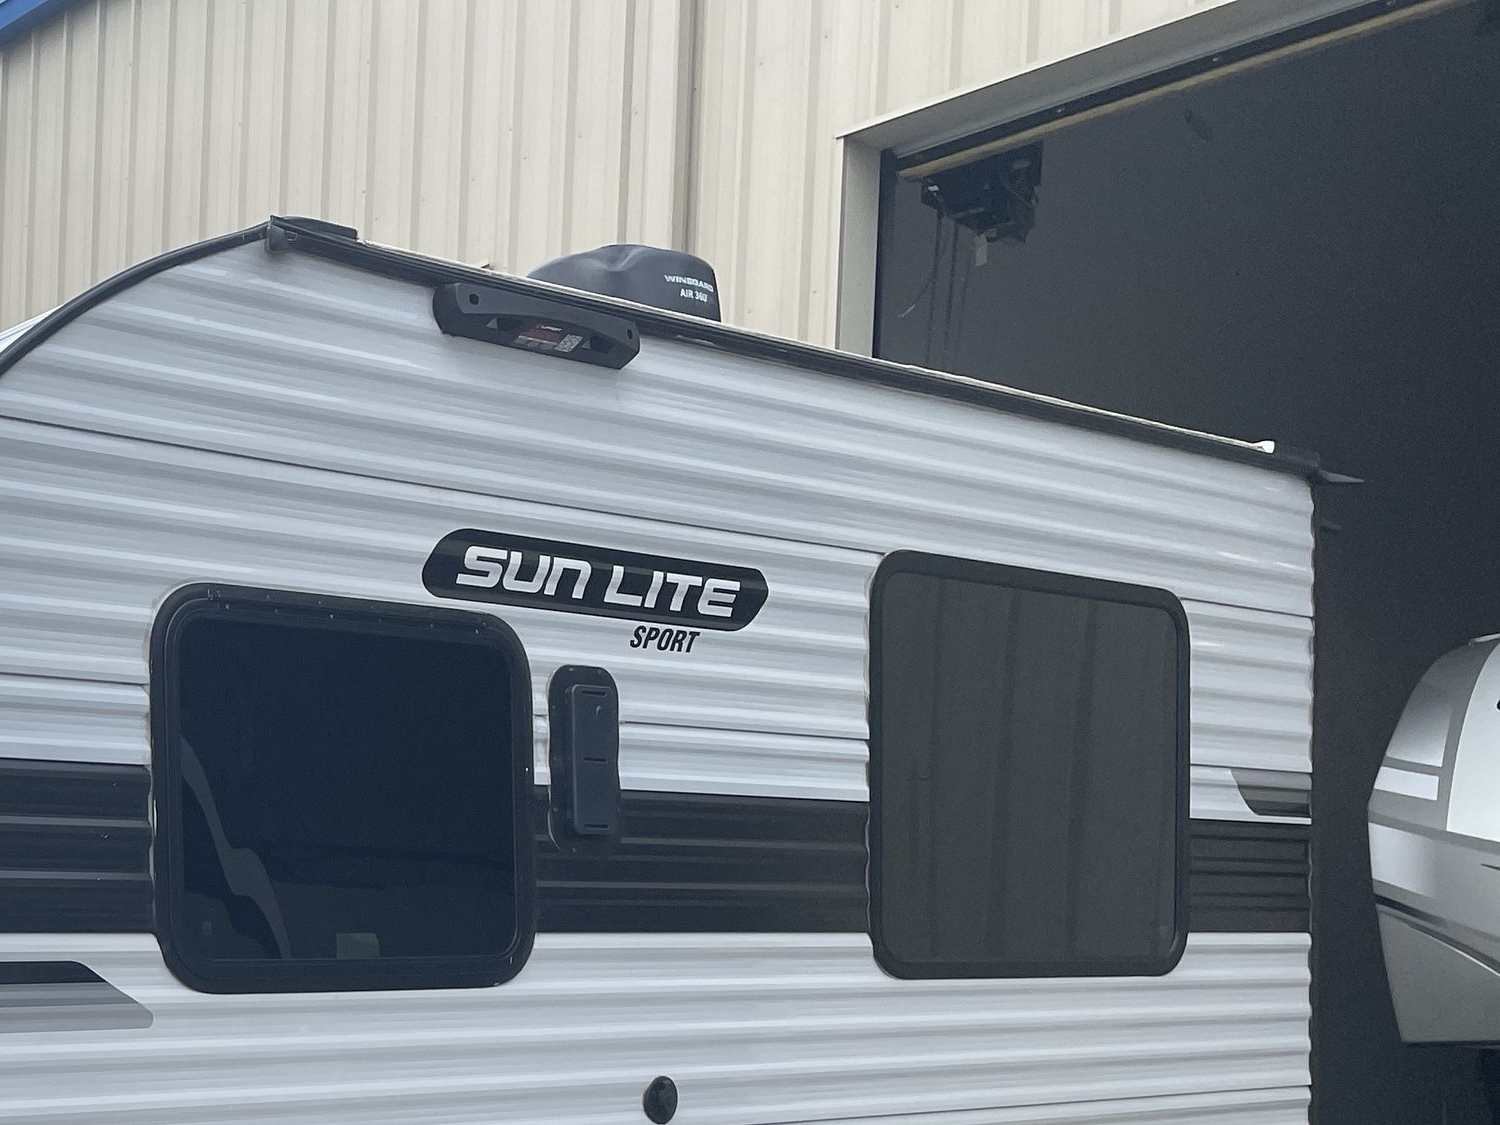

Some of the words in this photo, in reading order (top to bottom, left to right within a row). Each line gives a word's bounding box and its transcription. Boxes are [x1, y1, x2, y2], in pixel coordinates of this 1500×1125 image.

[680, 288, 694, 299] AIR
[456, 545, 592, 599] SUN
[603, 565, 741, 618] LITE
[630, 625, 701, 653] SPORT
